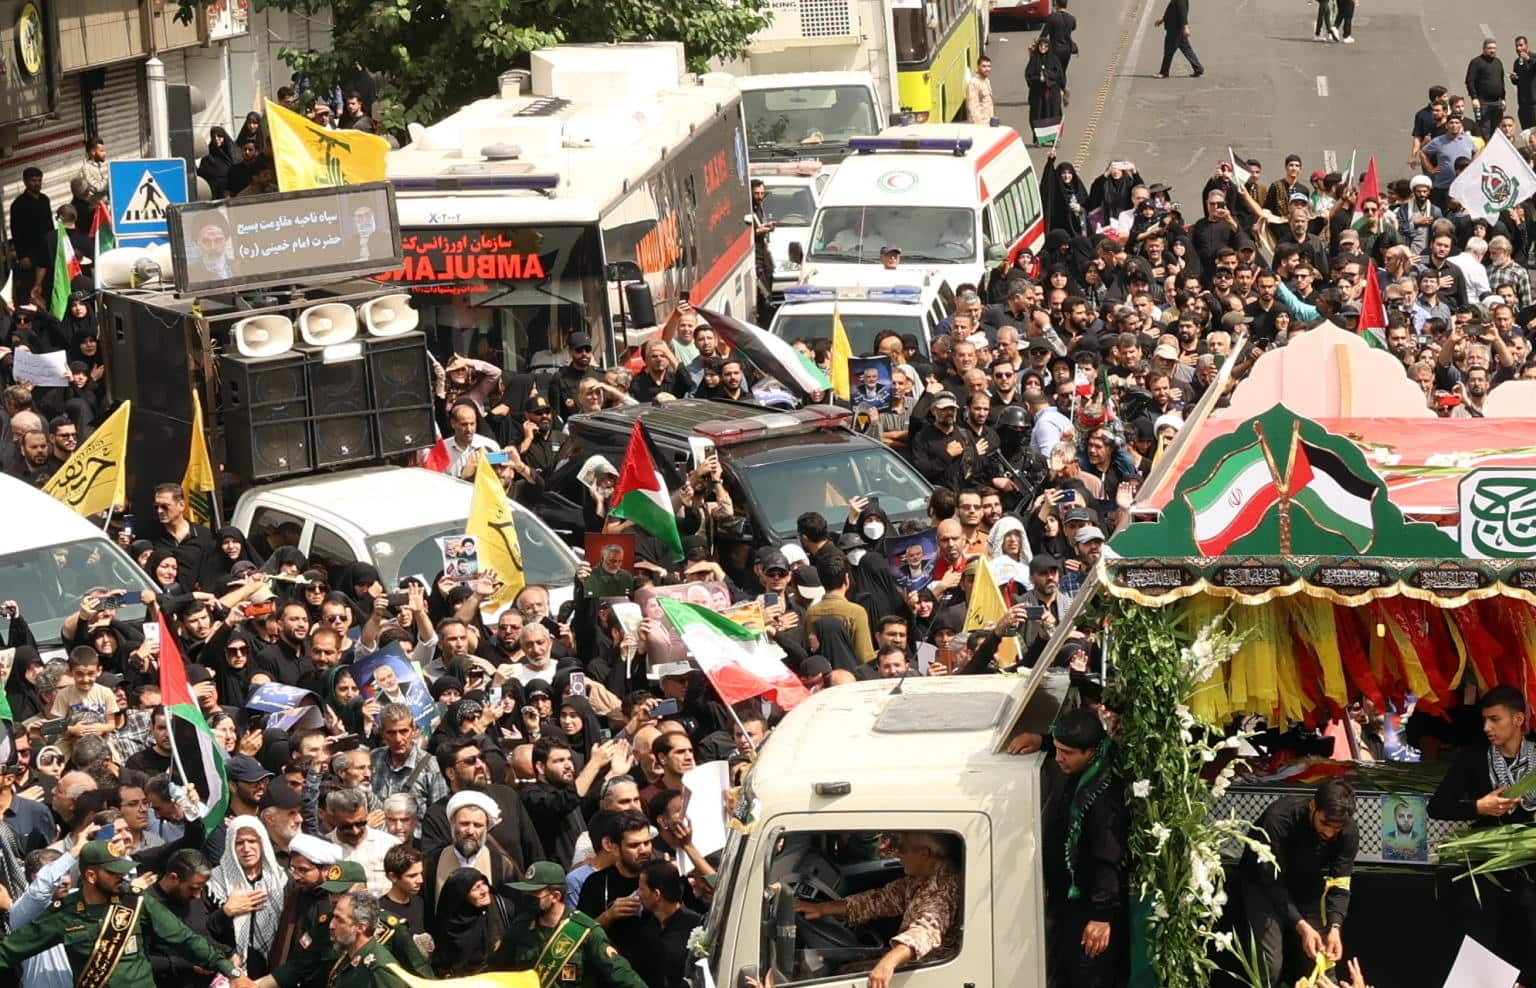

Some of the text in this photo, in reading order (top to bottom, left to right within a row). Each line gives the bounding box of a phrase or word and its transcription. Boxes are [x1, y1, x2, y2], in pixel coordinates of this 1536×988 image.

[236, 210, 338, 235] سپاه ناحیه مقاومت بسیج
[239, 233, 342, 259] حضرت امام خمینی (ره)
[416, 234, 468, 254] اورژانس
[470, 234, 513, 253] سازمان
